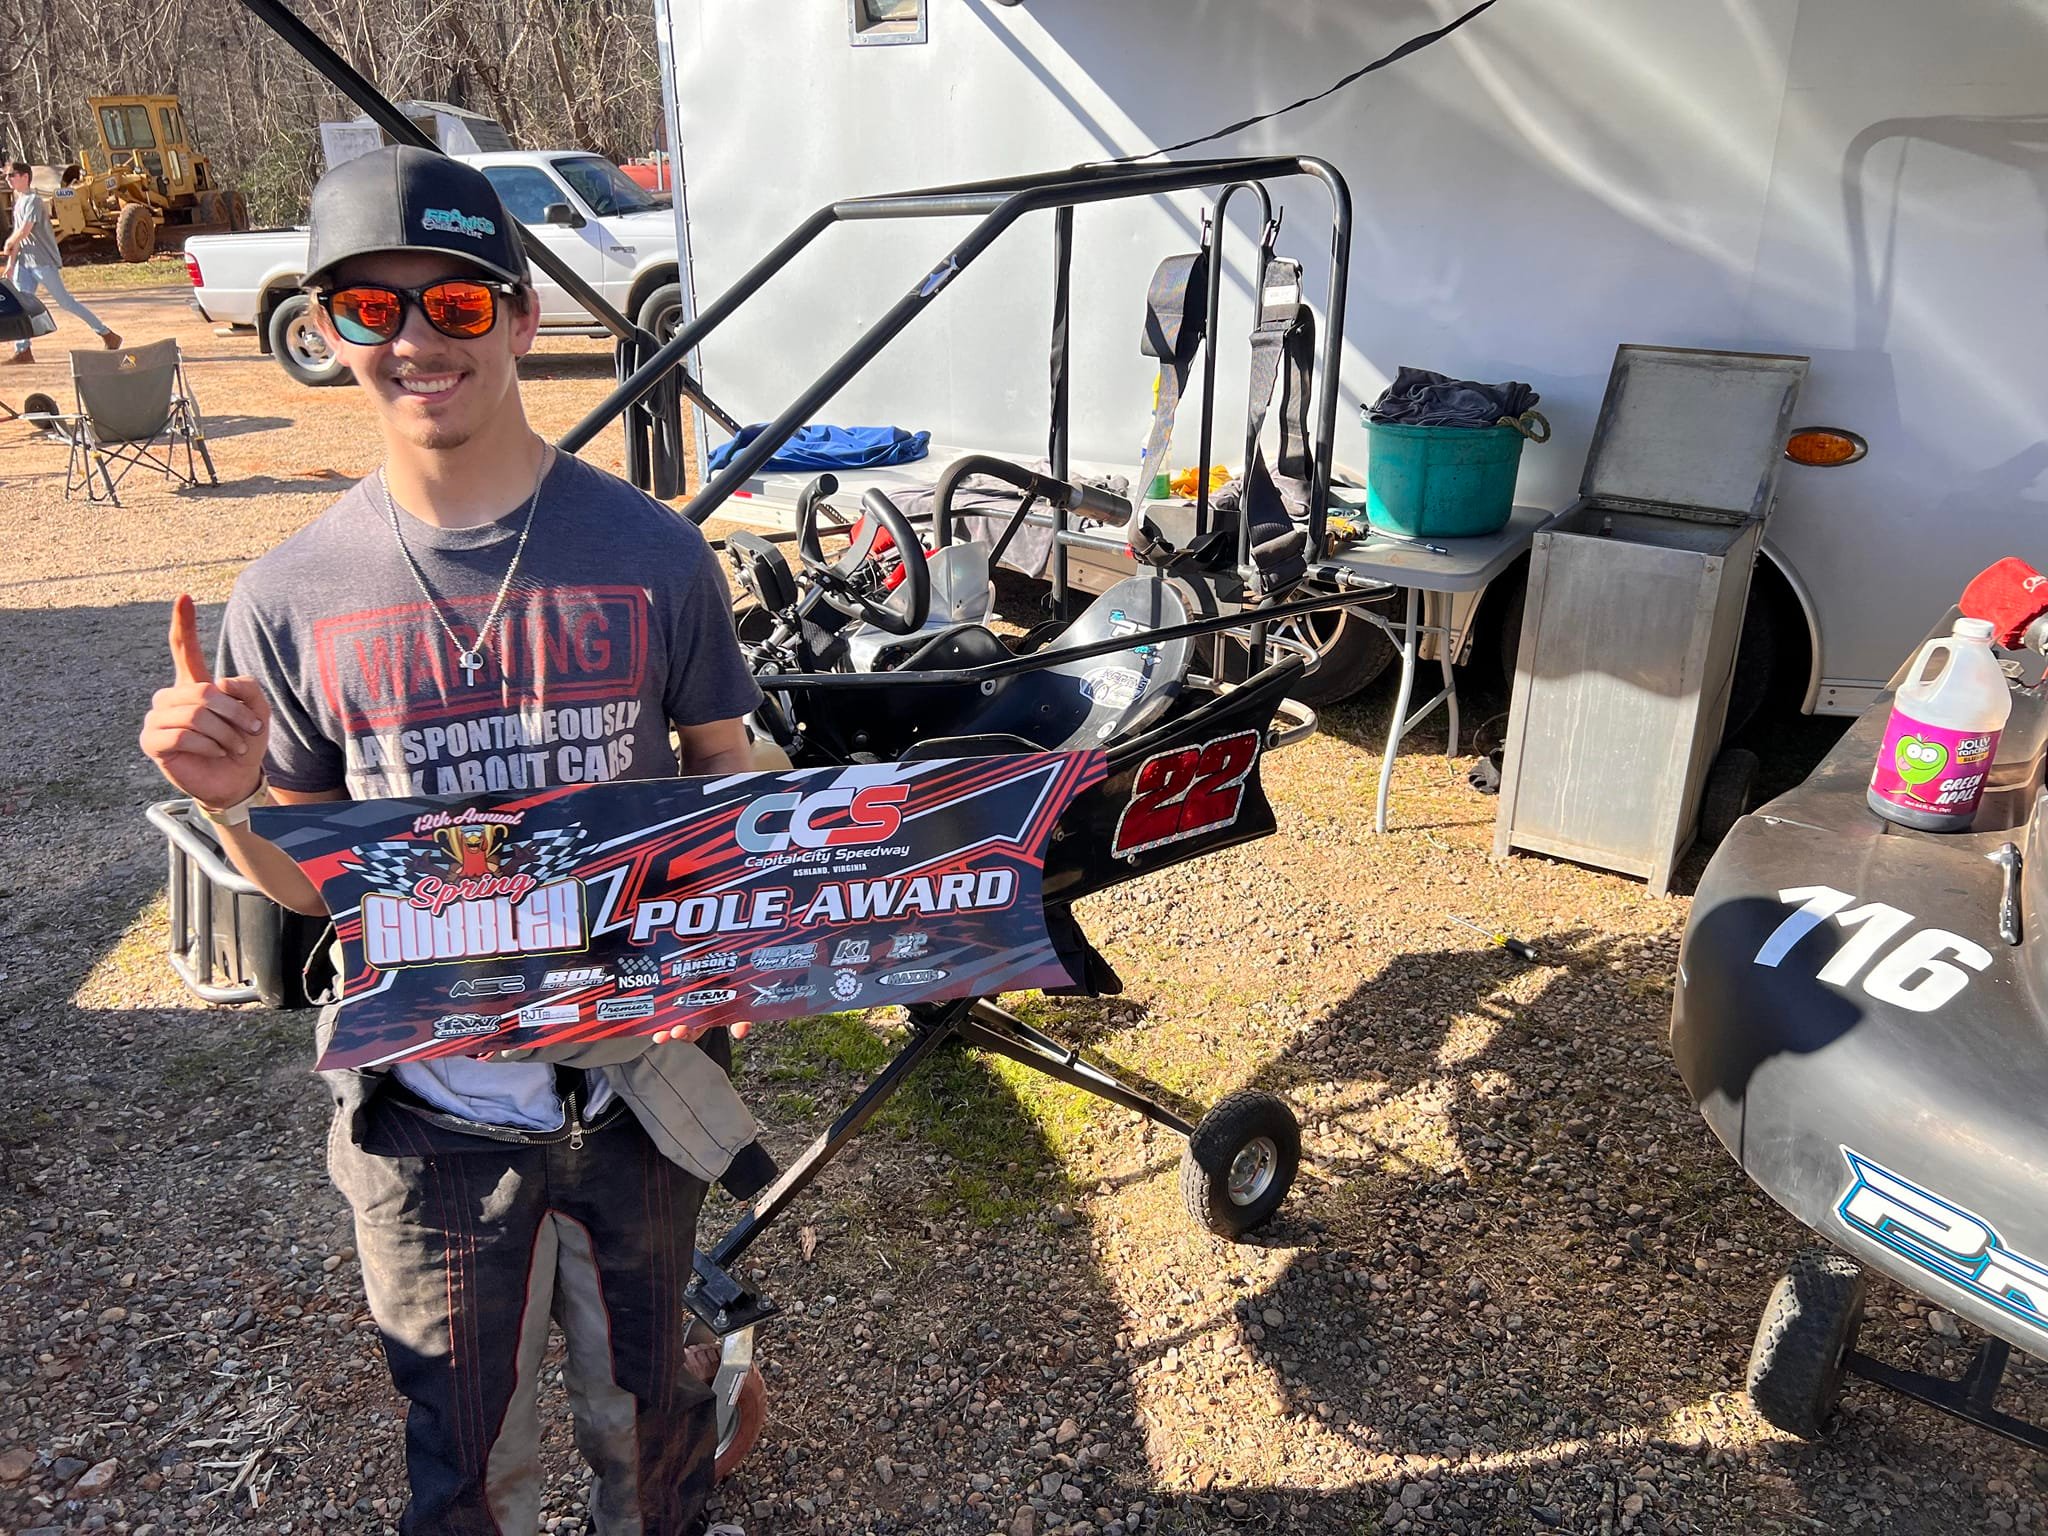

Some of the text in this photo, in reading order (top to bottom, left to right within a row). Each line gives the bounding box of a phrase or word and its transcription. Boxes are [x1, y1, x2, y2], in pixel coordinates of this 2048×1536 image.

[353, 610, 613, 706] WARNING
[402, 699, 641, 765] SPONTANEOUSLY
[1957, 736, 1990, 750] JOLLY
[437, 751, 549, 796] ABOUT
[556, 733, 634, 783] CARS
[1940, 773, 1983, 791] GREEN
[1111, 728, 1261, 860] 22
[1935, 787, 1978, 805] APPLE
[412, 807, 526, 833] 12th Annual
[735, 784, 911, 853] CCS
[744, 845, 910, 869] Capital City Speedway
[793, 863, 867, 877] ASHLAND, VIRGINIA
[408, 873, 537, 916] Spring
[632, 870, 1015, 941] POLE AWARD
[366, 880, 583, 965] GOBBLER
[834, 939, 870, 959] K1
[1754, 885, 1993, 1012] 716
[672, 956, 737, 976] HANSON'S
[834, 967, 857, 976] VARINA
[619, 974, 660, 988] NS804
[888, 969, 938, 985] MAXXIS
[688, 990, 730, 1001] S&M
[829, 983, 863, 1002] LANDSCAPING
[521, 1009, 543, 1020] RJT
[598, 1002, 653, 1015] Premier
